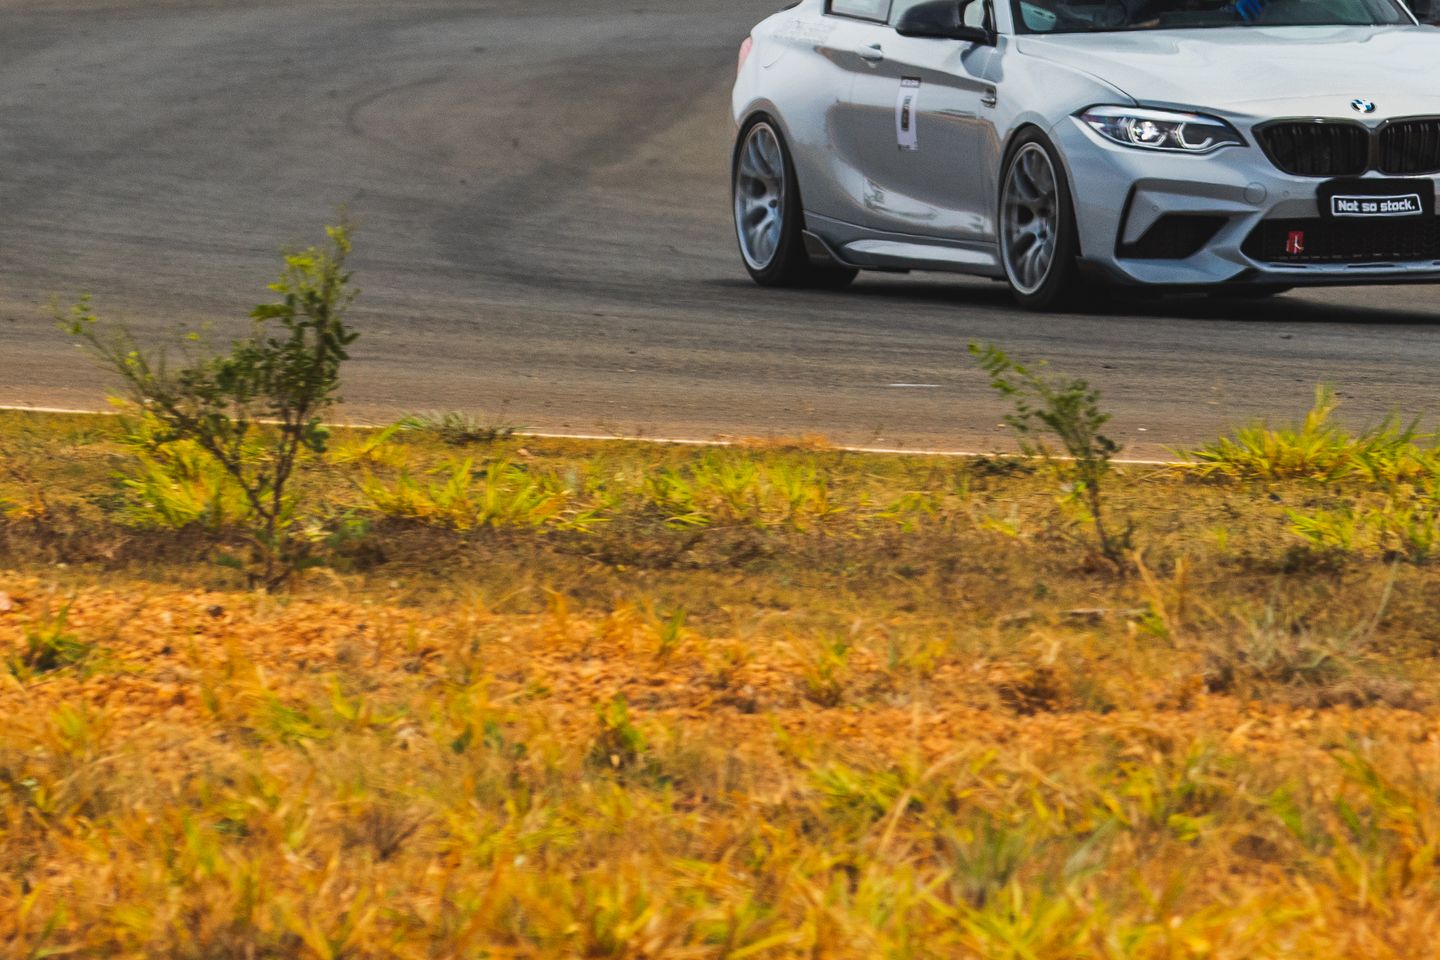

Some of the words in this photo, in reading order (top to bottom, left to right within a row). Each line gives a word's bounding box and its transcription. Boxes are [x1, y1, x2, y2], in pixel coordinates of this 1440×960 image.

[1338, 200, 1359, 211] Not
[1361, 202, 1377, 212] so
[1380, 199, 1415, 212] stock.
